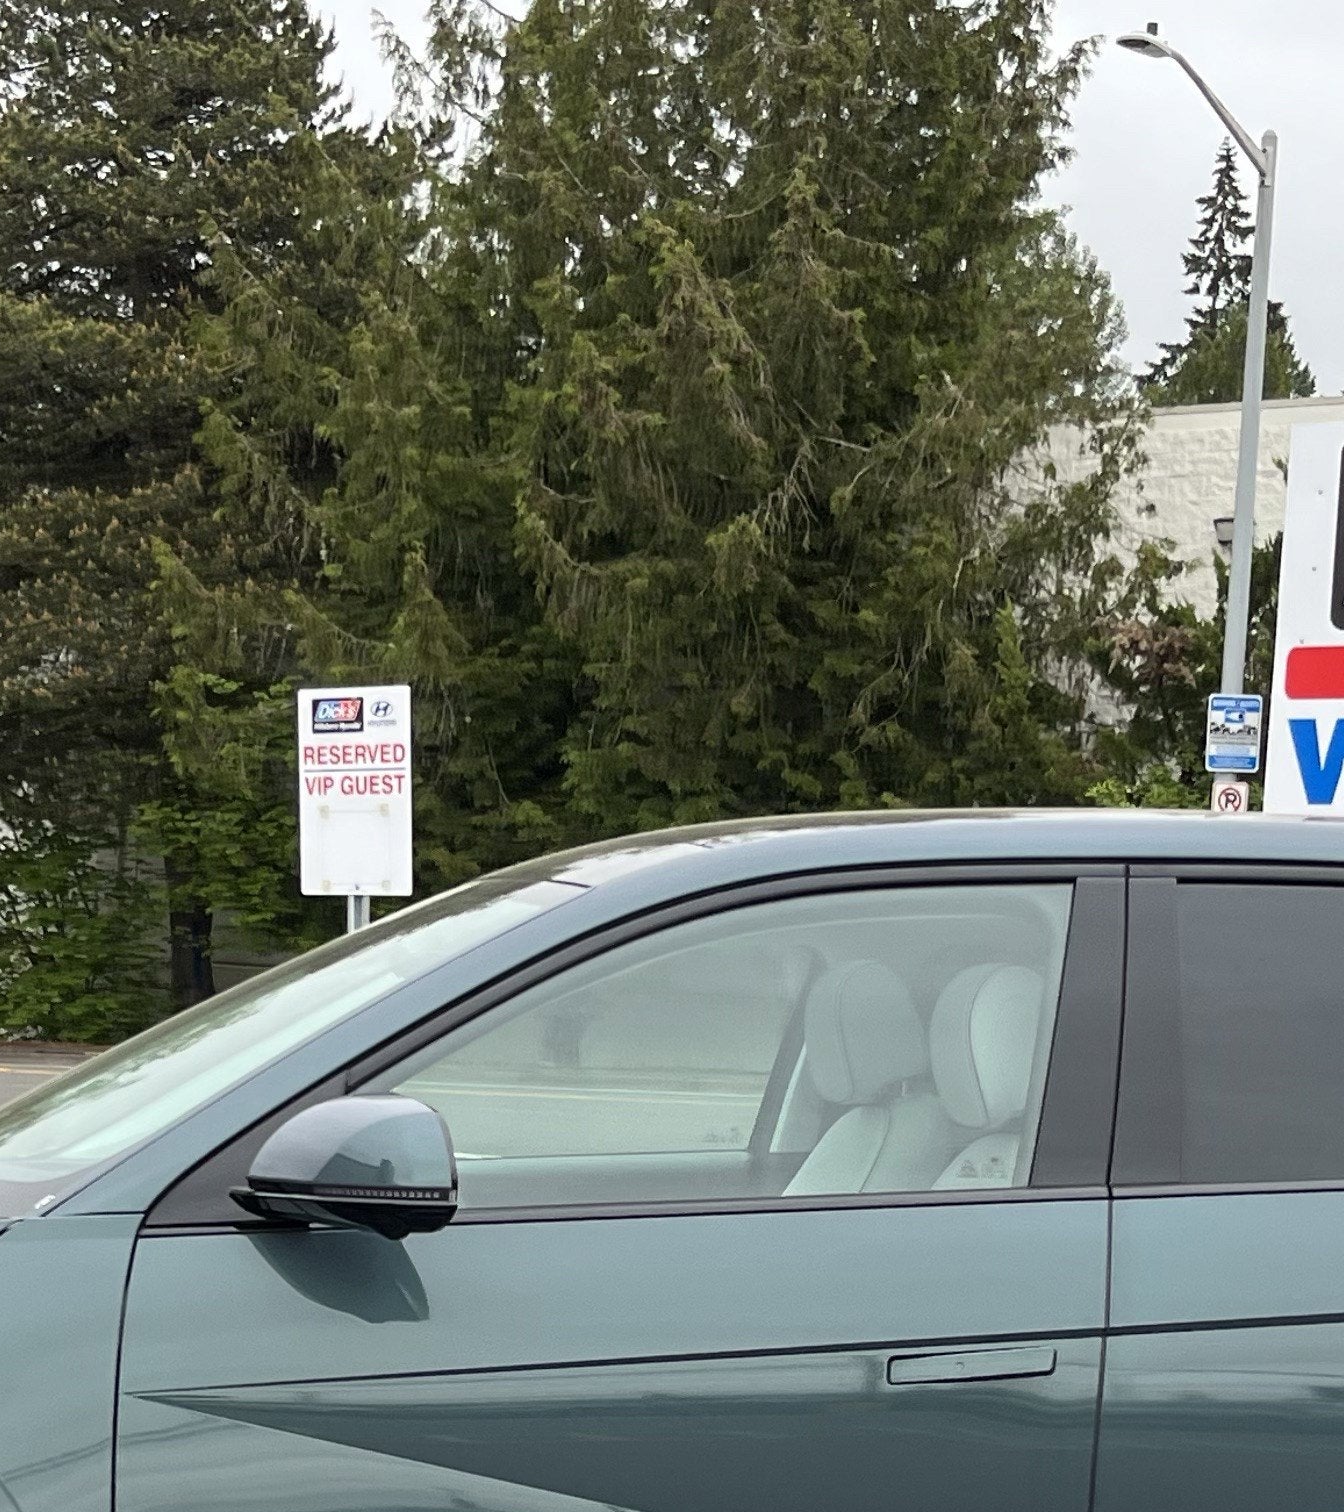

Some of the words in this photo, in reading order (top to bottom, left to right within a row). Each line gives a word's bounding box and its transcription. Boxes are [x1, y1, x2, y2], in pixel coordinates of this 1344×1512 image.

[303, 744, 405, 765] RESERVED
[305, 776, 333, 796] VIP
[340, 775, 405, 796] GUEST
